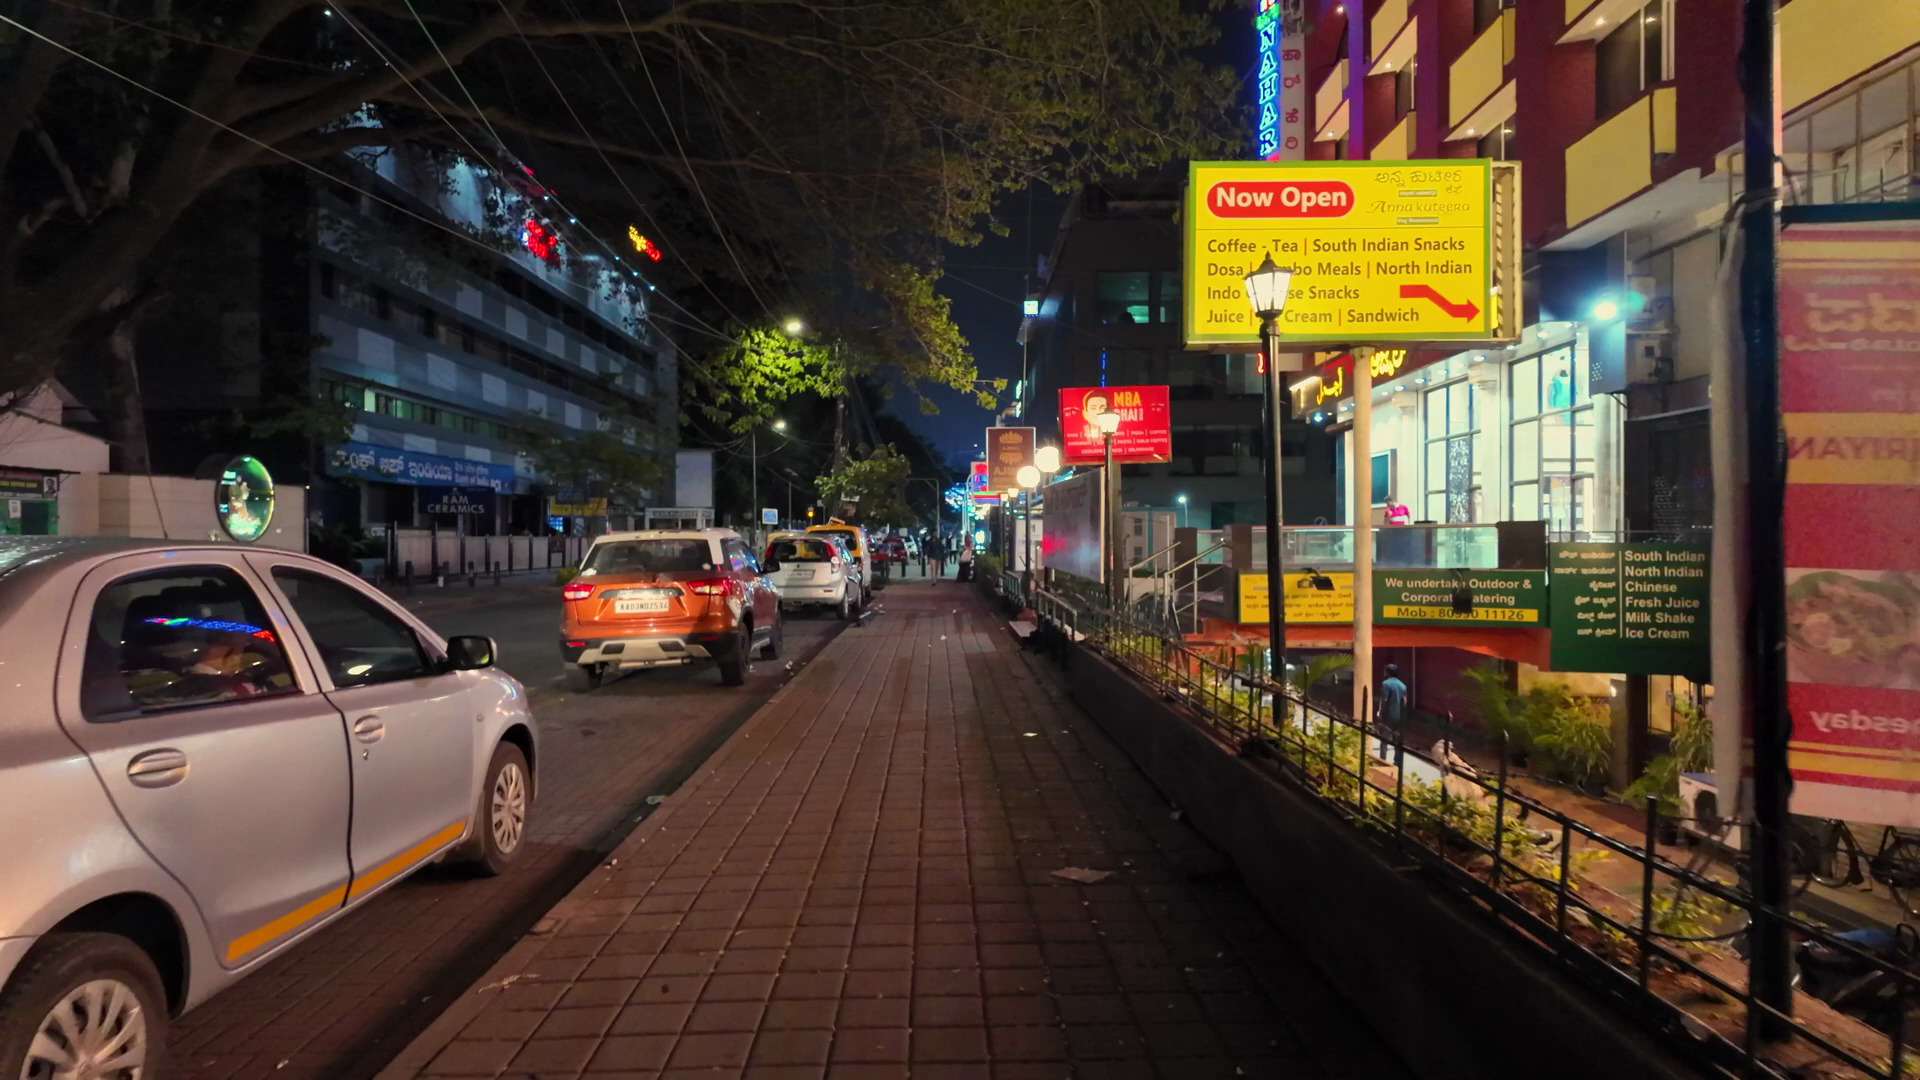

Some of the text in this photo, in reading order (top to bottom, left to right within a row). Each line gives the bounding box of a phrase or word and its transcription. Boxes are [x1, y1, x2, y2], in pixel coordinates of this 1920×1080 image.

[1258, 20, 1278, 156] NAHAR
[1216, 187, 1347, 212] Now Open
[1366, 200, 1413, 213] Anna
[1207, 238, 1257, 253] Coffee
[1272, 239, 1299, 252] Tea
[1313, 238, 1357, 252] South
[1362, 238, 1409, 252] Indian
[1414, 237, 1465, 252] Snacks
[1207, 262, 1244, 276] Dosa
[1317, 262, 1362, 276] Meals
[1376, 261, 1422, 276] North
[1426, 260, 1472, 275] Indian
[1207, 286, 1241, 300] Indo
[1309, 286, 1360, 300] Snacks
[1207, 309, 1244, 324] Juice
[1284, 310, 1333, 323] Cream
[1347, 308, 1420, 323] Sandwich
[1113, 391, 1142, 407] MBA
[442, 495, 469, 504] RAM
[427, 504, 485, 514] CERAMICS
[1624, 550, 1705, 562] South Indian
[1625, 566, 1704, 577] North Indian
[1385, 578, 1404, 588] We
[1469, 578, 1520, 589] Outdoor
[1523, 579, 1532, 589] &
[1625, 581, 1678, 593] Chinese
[1401, 592, 1516, 605] Corporat atering
[1625, 597, 1701, 609] Fresh Juice
[1397, 607, 1427, 618] Mob
[1484, 609, 1525, 620] 11126
[1625, 612, 1695, 624] Milk Shake
[1625, 627, 1690, 639] Ice Cream
